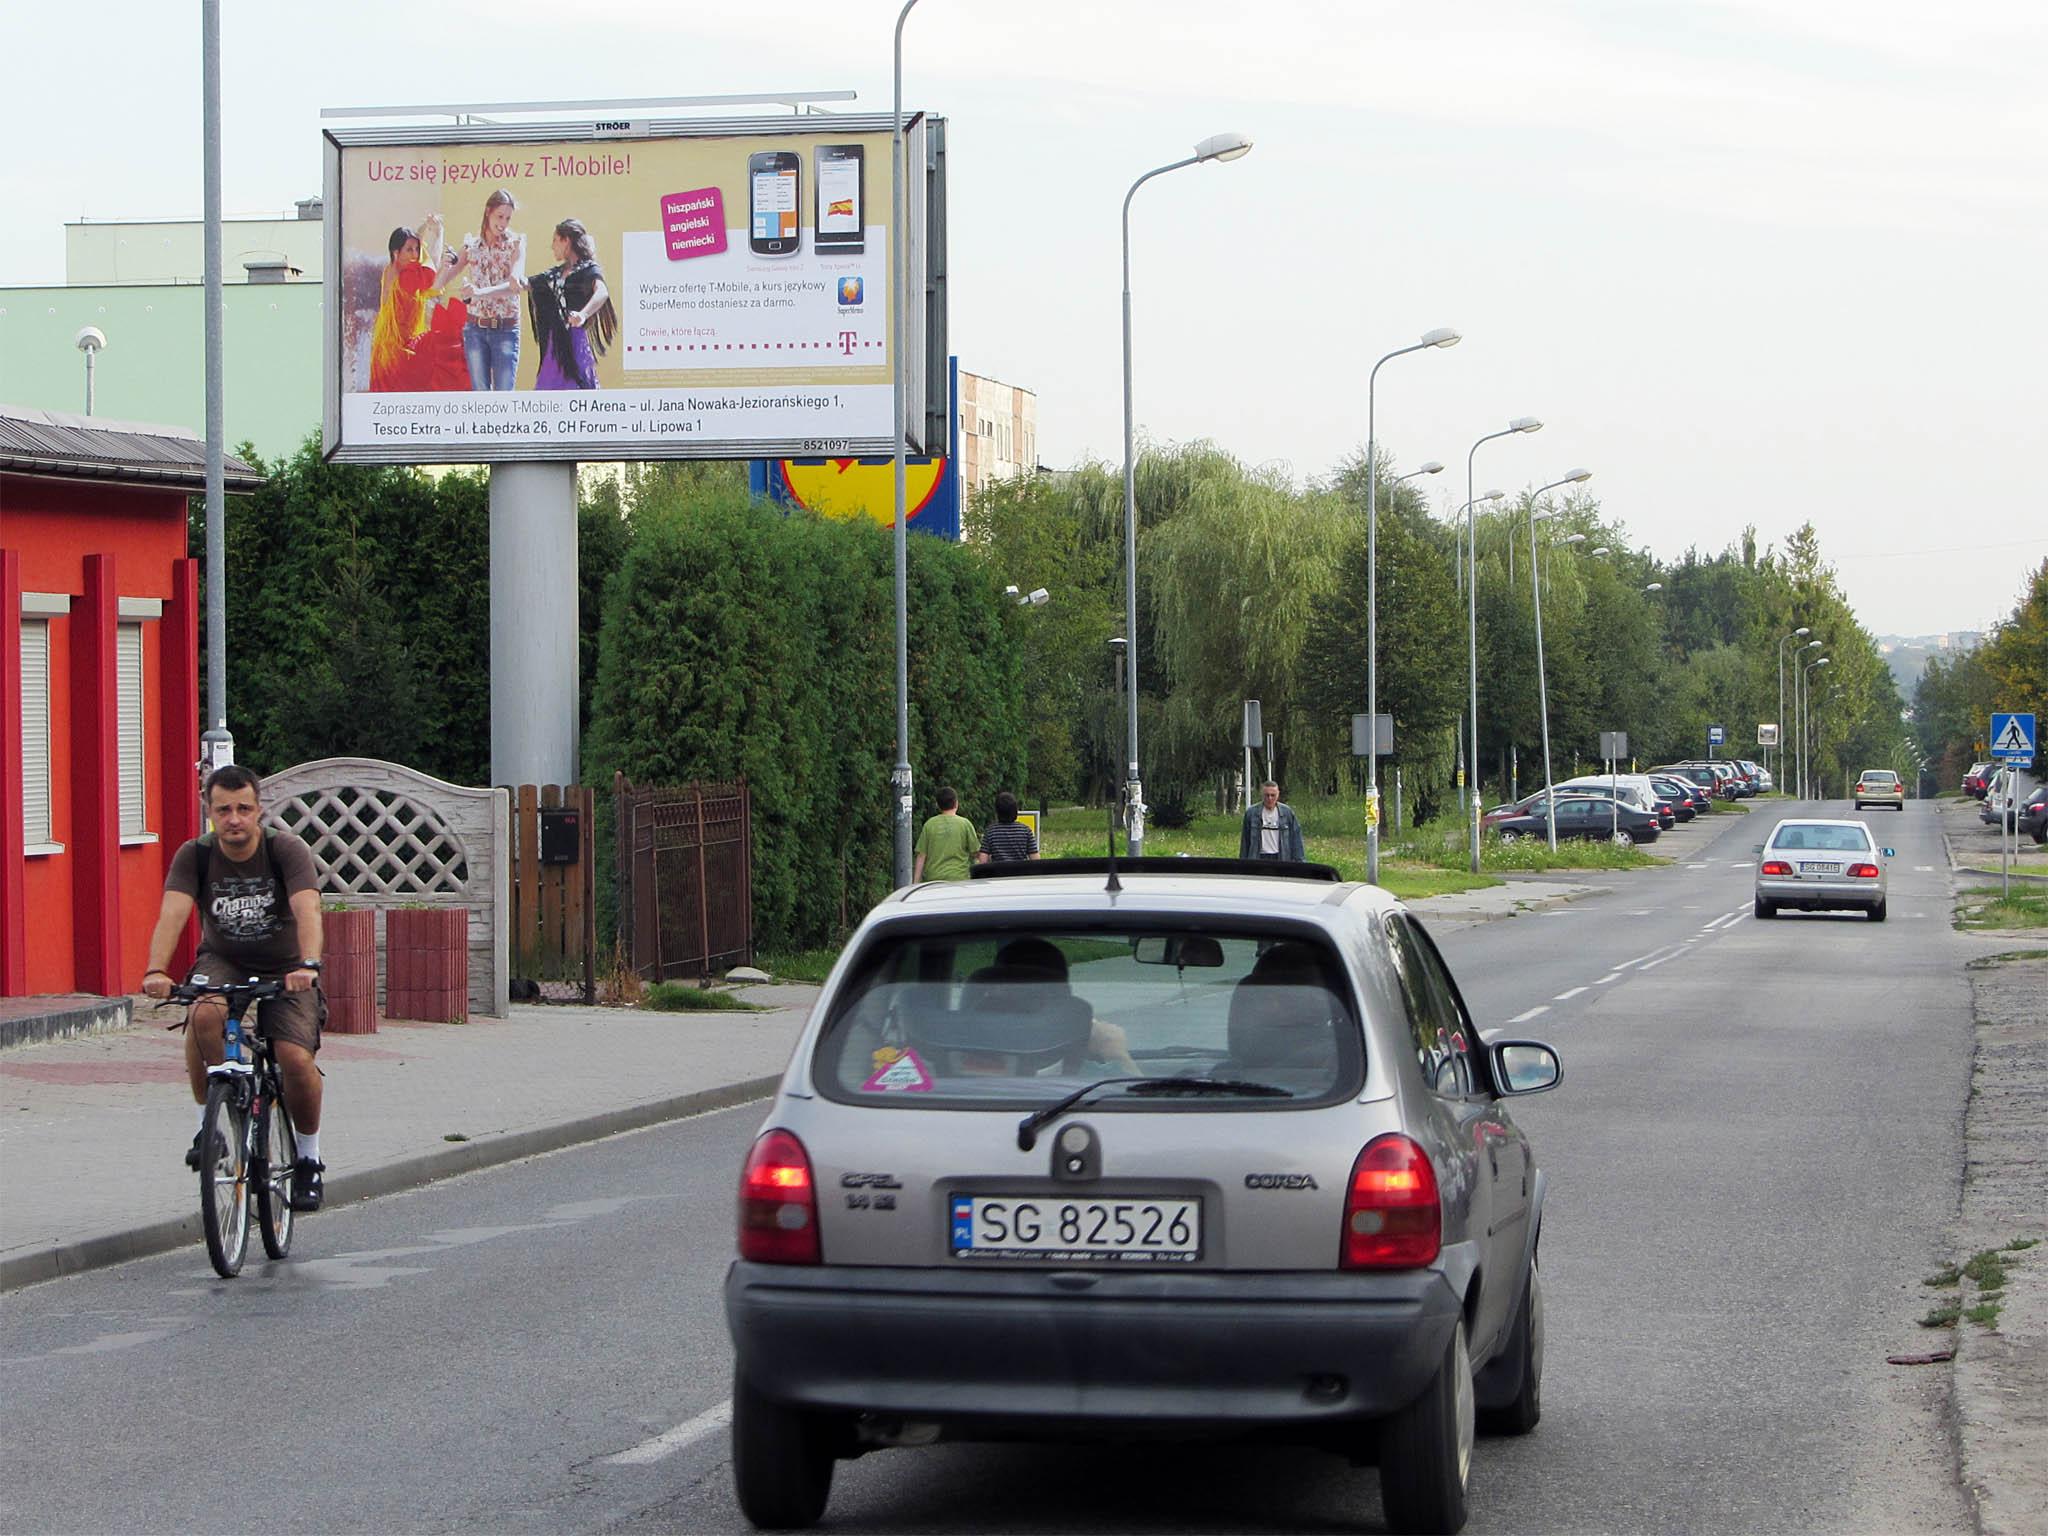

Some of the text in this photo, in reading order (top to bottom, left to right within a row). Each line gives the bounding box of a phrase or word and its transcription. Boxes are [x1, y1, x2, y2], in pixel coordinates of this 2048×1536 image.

[595, 121, 631, 131] STRÖER
[367, 153, 632, 185] Ucz się języków z T-Mobile!
[666, 196, 715, 214] hiszpański
[669, 215, 710, 233] angielski
[671, 233, 715, 251] niemiecki
[639, 279, 826, 296] Wybierz ofertę T-Mobile, a kurs językowy
[639, 297, 796, 311] SuperMemo dostaniesz za darmo.
[639, 327, 670, 338] Chwile,
[671, 326, 692, 337] które
[838, 331, 858, 355] T
[372, 401, 441, 417] Zapraszamy
[443, 401, 459, 414] do
[461, 400, 508, 415] sklepów
[511, 400, 563, 413] T-Mobile:
[568, 400, 588, 413] CH
[590, 399, 627, 413] Arena
[639, 399, 655, 412] ul.
[657, 398, 685, 412] Jana
[687, 395, 830, 411] Nowaka-Jeziorańskiego
[833, 395, 845, 409] 1,
[372, 422, 408, 436] Tesco
[410, 422, 442, 436] Extra
[454, 421, 469, 435] ul.
[471, 421, 530, 437] Łabędzka
[533, 420, 552, 435] 26,
[557, 421, 576, 433] CH
[579, 420, 618, 434] Forum
[631, 420, 646, 434] ul.
[649, 419, 693, 435] Lipowa
[696, 419, 702, 432] 1
[803, 440, 848, 451] 8521097
[1244, 1173, 1319, 1191] CORSA
[981, 1202, 1191, 1247] SG 82526
